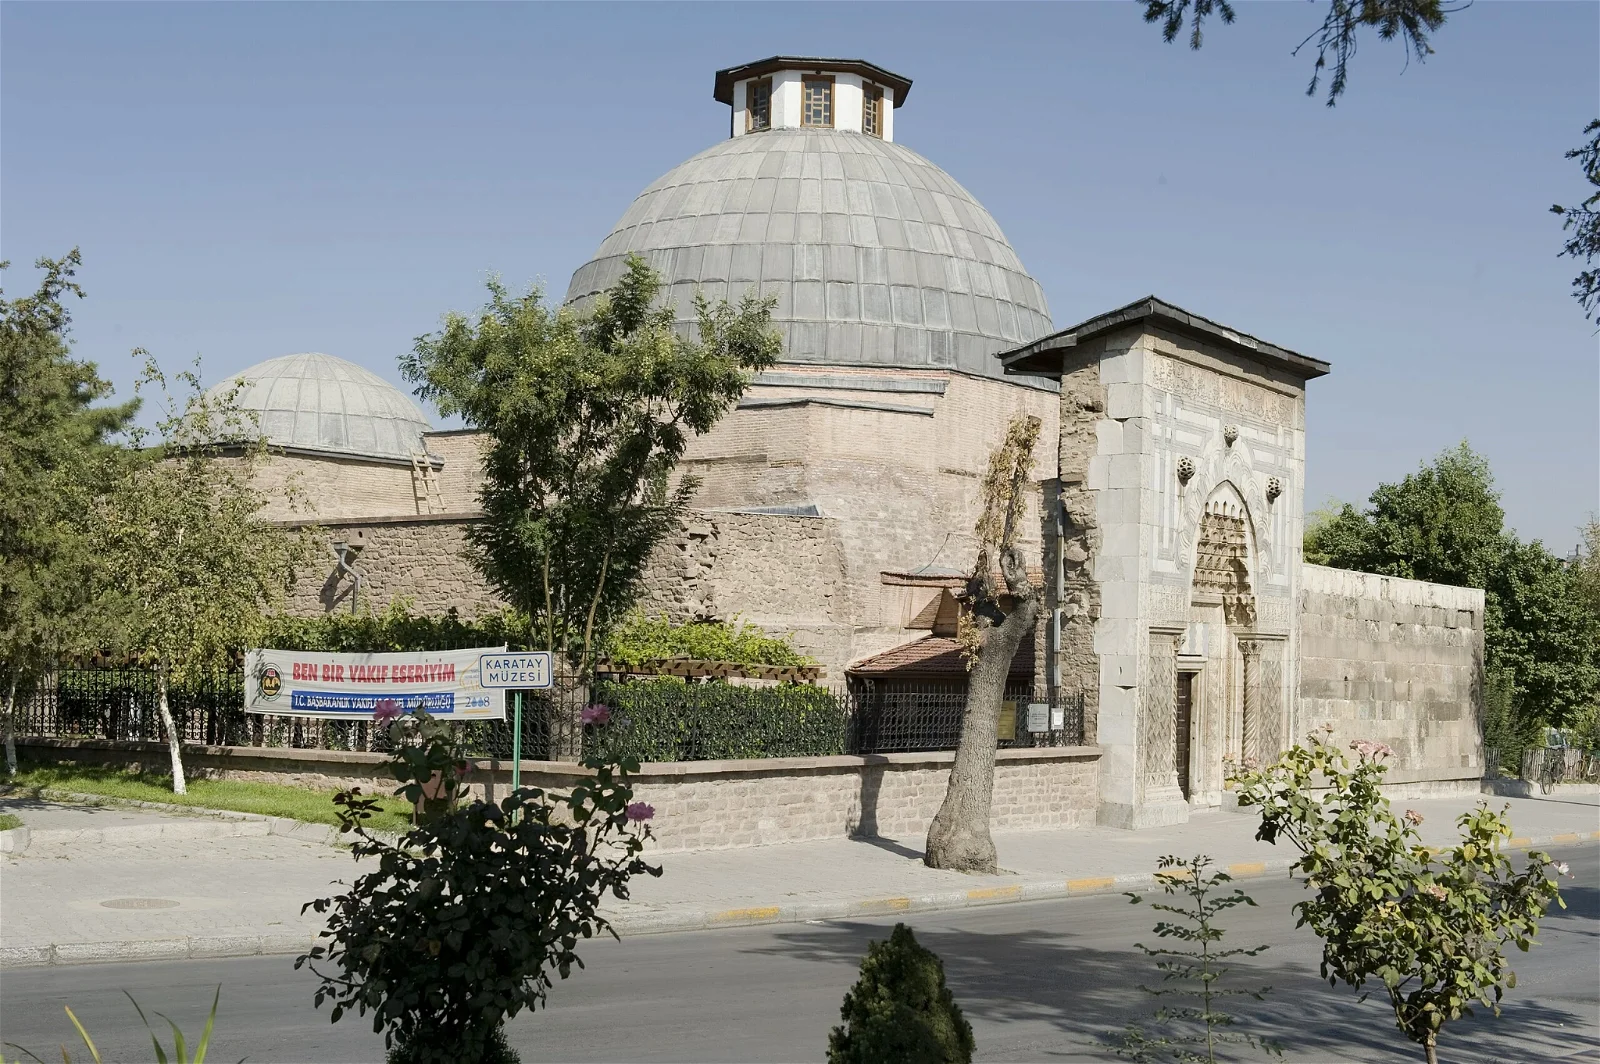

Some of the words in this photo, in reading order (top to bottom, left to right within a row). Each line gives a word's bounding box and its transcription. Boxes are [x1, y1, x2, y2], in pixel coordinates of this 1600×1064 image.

[293, 662, 318, 681] BEN
[322, 659, 345, 683] BİR
[348, 664, 389, 683] VAKIF
[391, 658, 456, 684] ESERİYİM
[486, 659, 543, 670] KARATAY
[489, 670, 541, 683] MÜZESİ
[294, 694, 306, 707] T.C.
[306, 695, 350, 710] BAŞBAKANLIK
[352, 697, 382, 709] VAKIFLA
